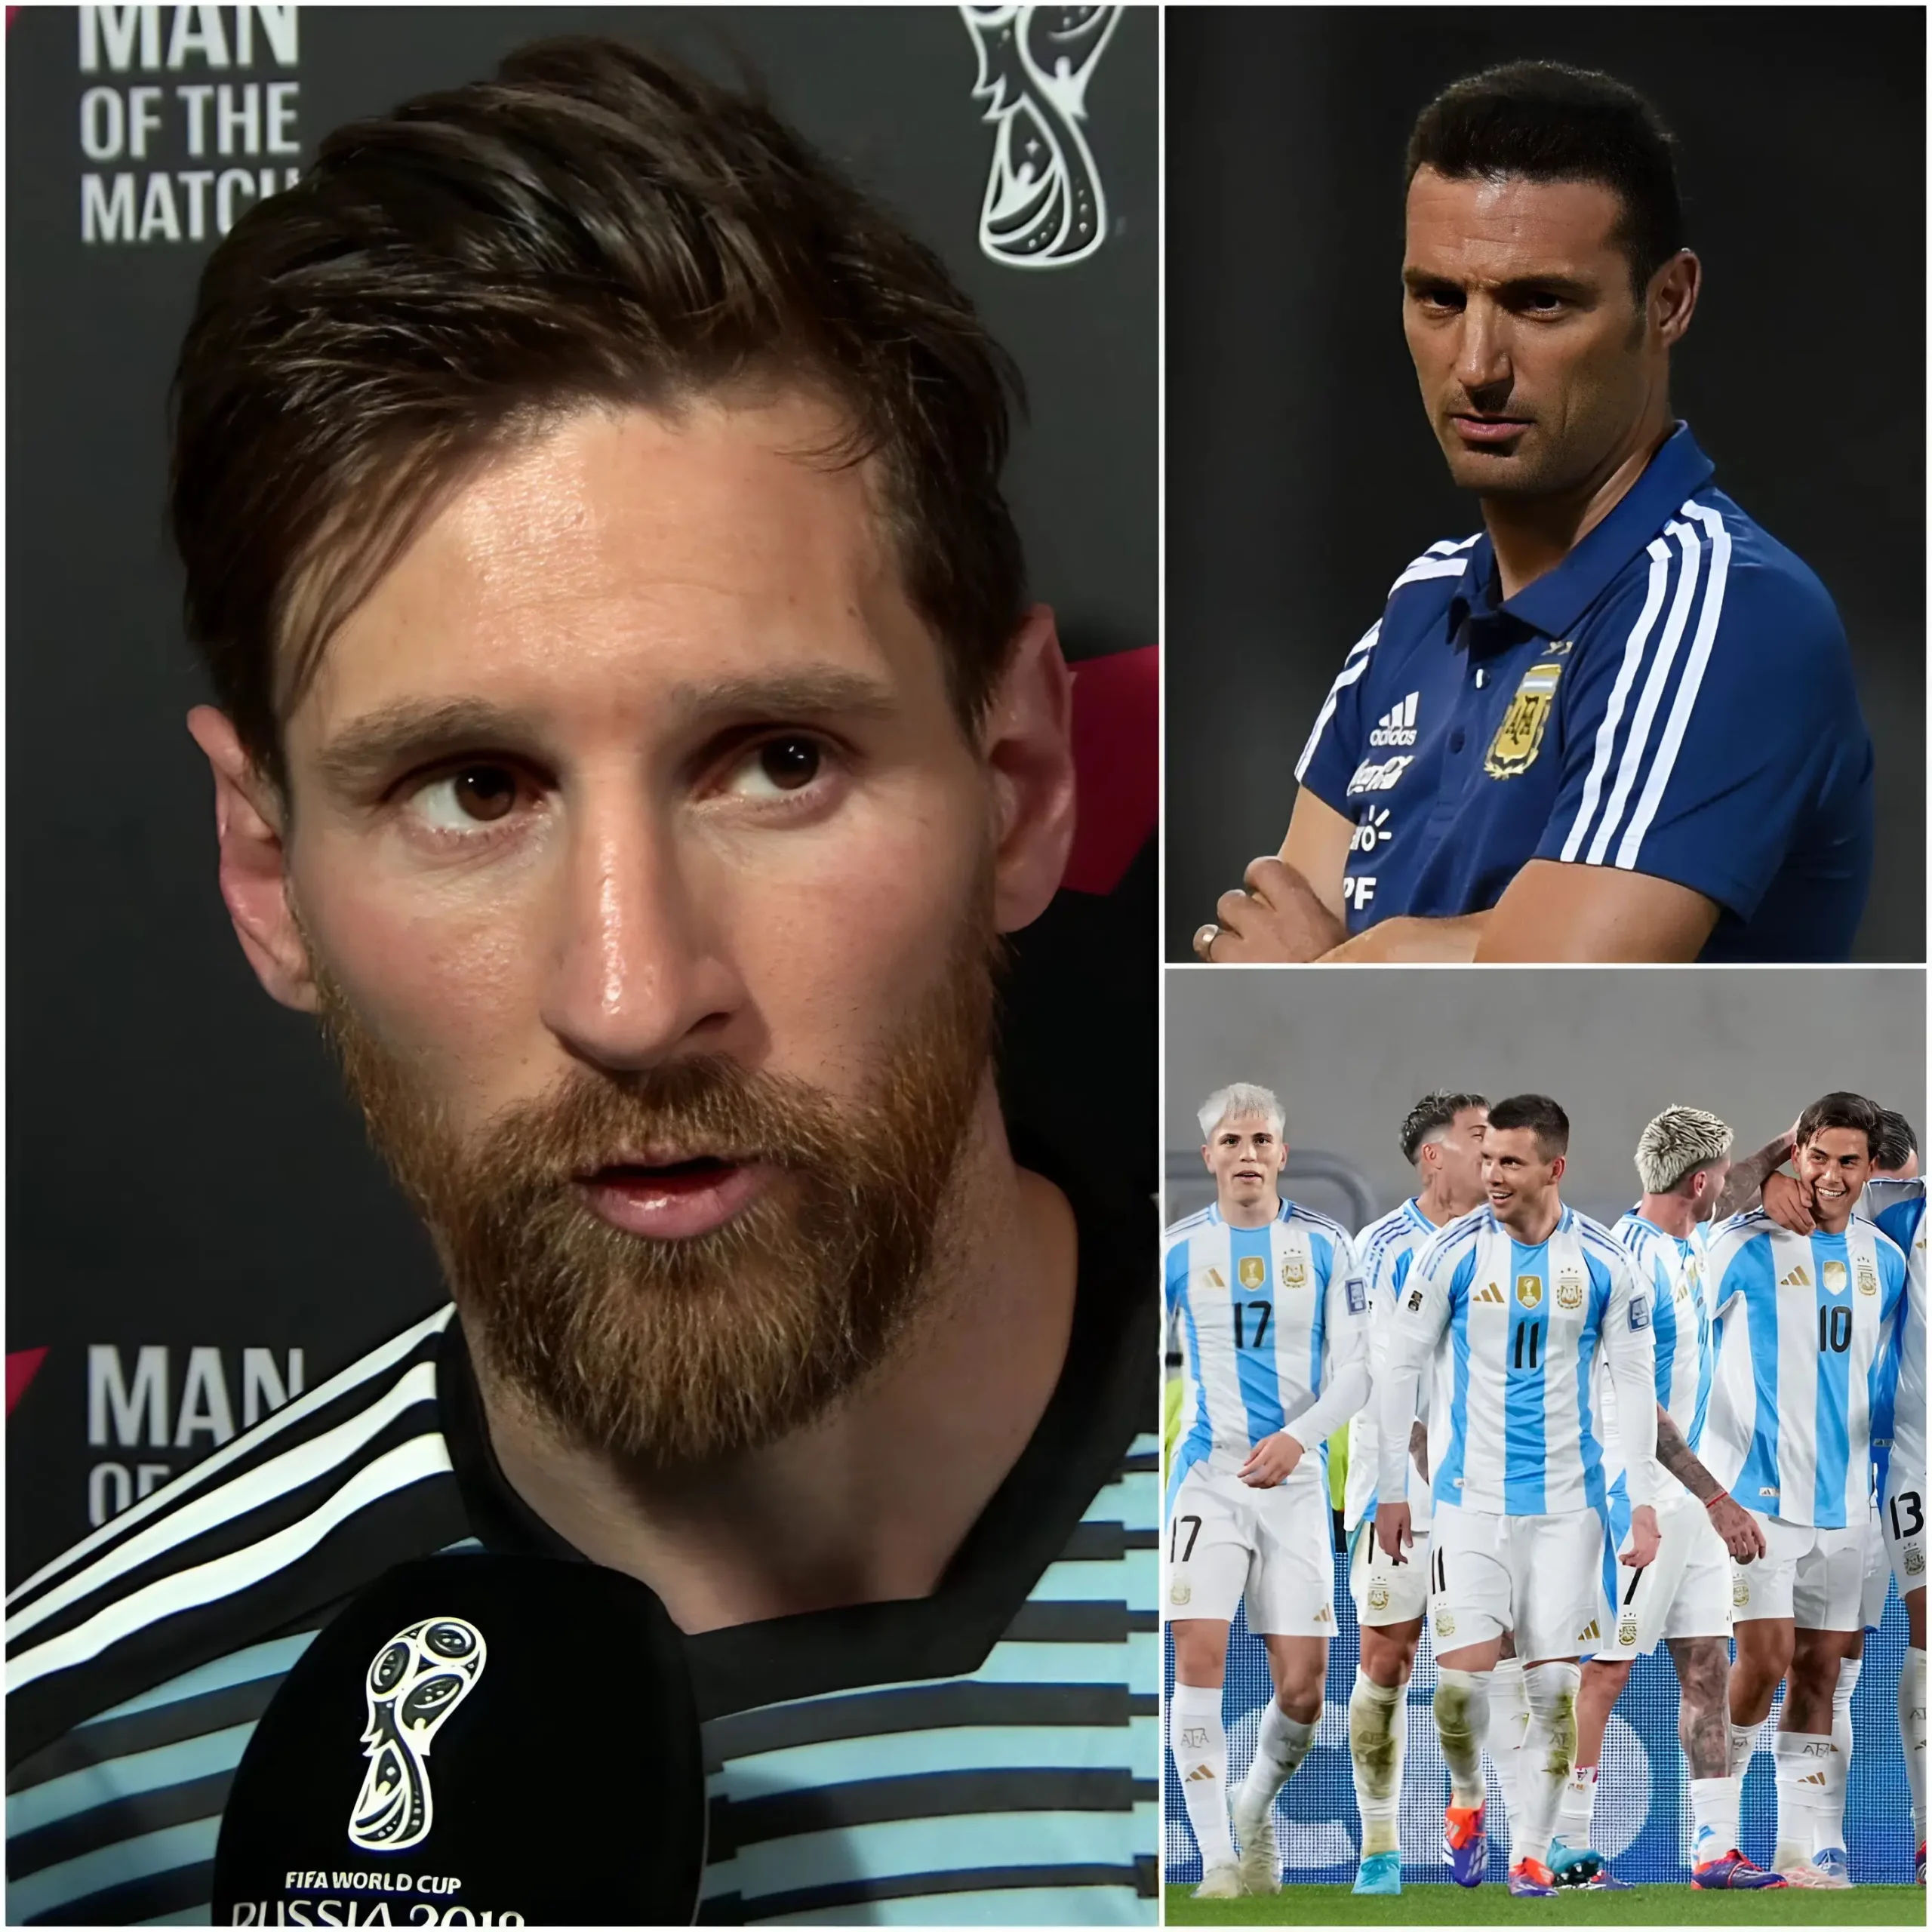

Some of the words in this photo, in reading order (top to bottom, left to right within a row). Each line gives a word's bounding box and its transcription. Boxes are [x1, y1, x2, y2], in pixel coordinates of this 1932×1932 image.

[78, 5, 300, 72] MAN
[80, 86, 162, 159] OF
[177, 82, 300, 156] THE
[82, 165, 300, 242] MATC
[1234, 1300, 1272, 1349] 17
[1514, 1321, 1540, 1369] 11
[1820, 1305, 1852, 1353] 10
[88, 1345, 304, 1447] MAN
[1170, 1515, 1202, 1563] 17
[1889, 1491, 1924, 1541] 13
[285, 1870, 329, 1889] FIFA
[332, 1871, 413, 1892] WORLD
[417, 1875, 462, 1895] CUP
